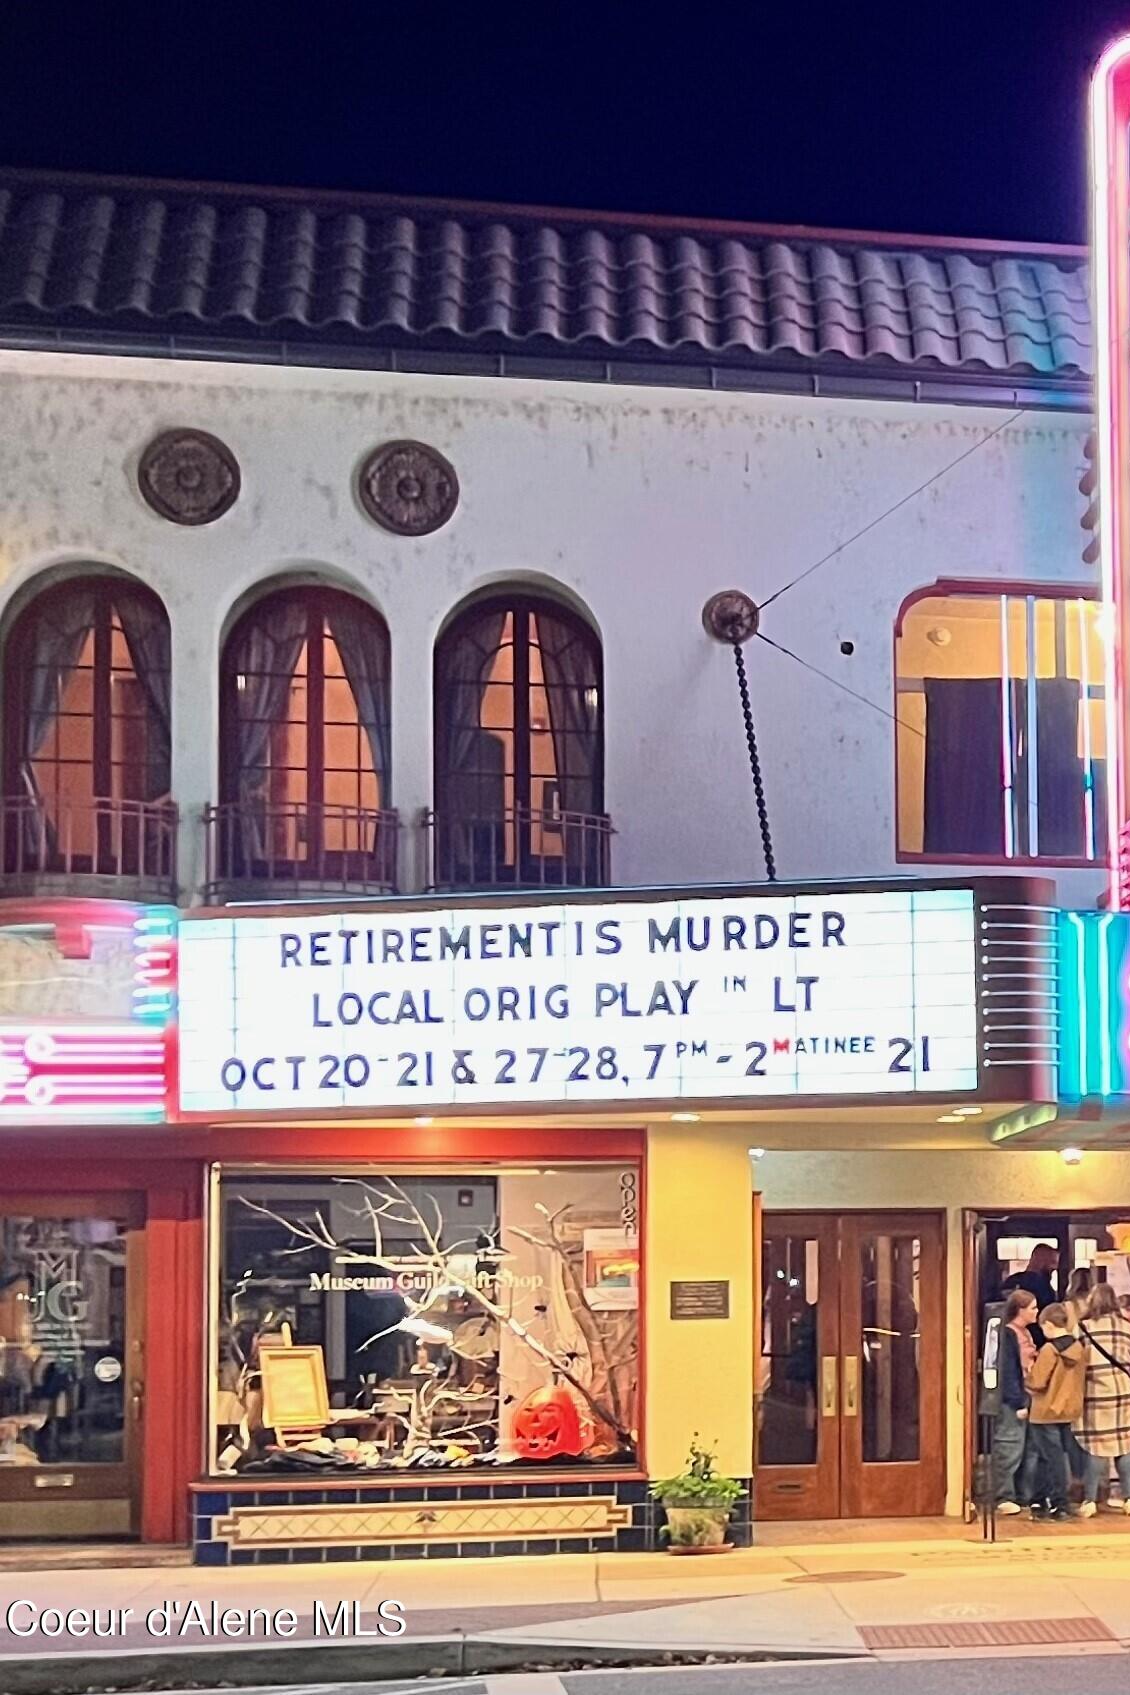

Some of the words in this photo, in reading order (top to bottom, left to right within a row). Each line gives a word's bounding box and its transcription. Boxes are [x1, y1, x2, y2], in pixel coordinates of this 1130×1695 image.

[280, 920, 562, 968] RETIREMENT
[575, 919, 622, 956] IS
[648, 911, 846, 954] MURDER
[313, 989, 444, 1027] LOCAL
[464, 984, 570, 1022] ORIG
[595, 979, 699, 1018] PLAY
[723, 975, 747, 993] IN
[773, 976, 819, 1012] LT
[220, 1056, 306, 1092] OCT
[451, 1049, 477, 1084] &
[773, 1036, 875, 1056] MATINEE
[887, 1036, 931, 1073] 21
[309, 1272, 394, 1291] Museum
[396, 1272, 446, 1290] Guil
